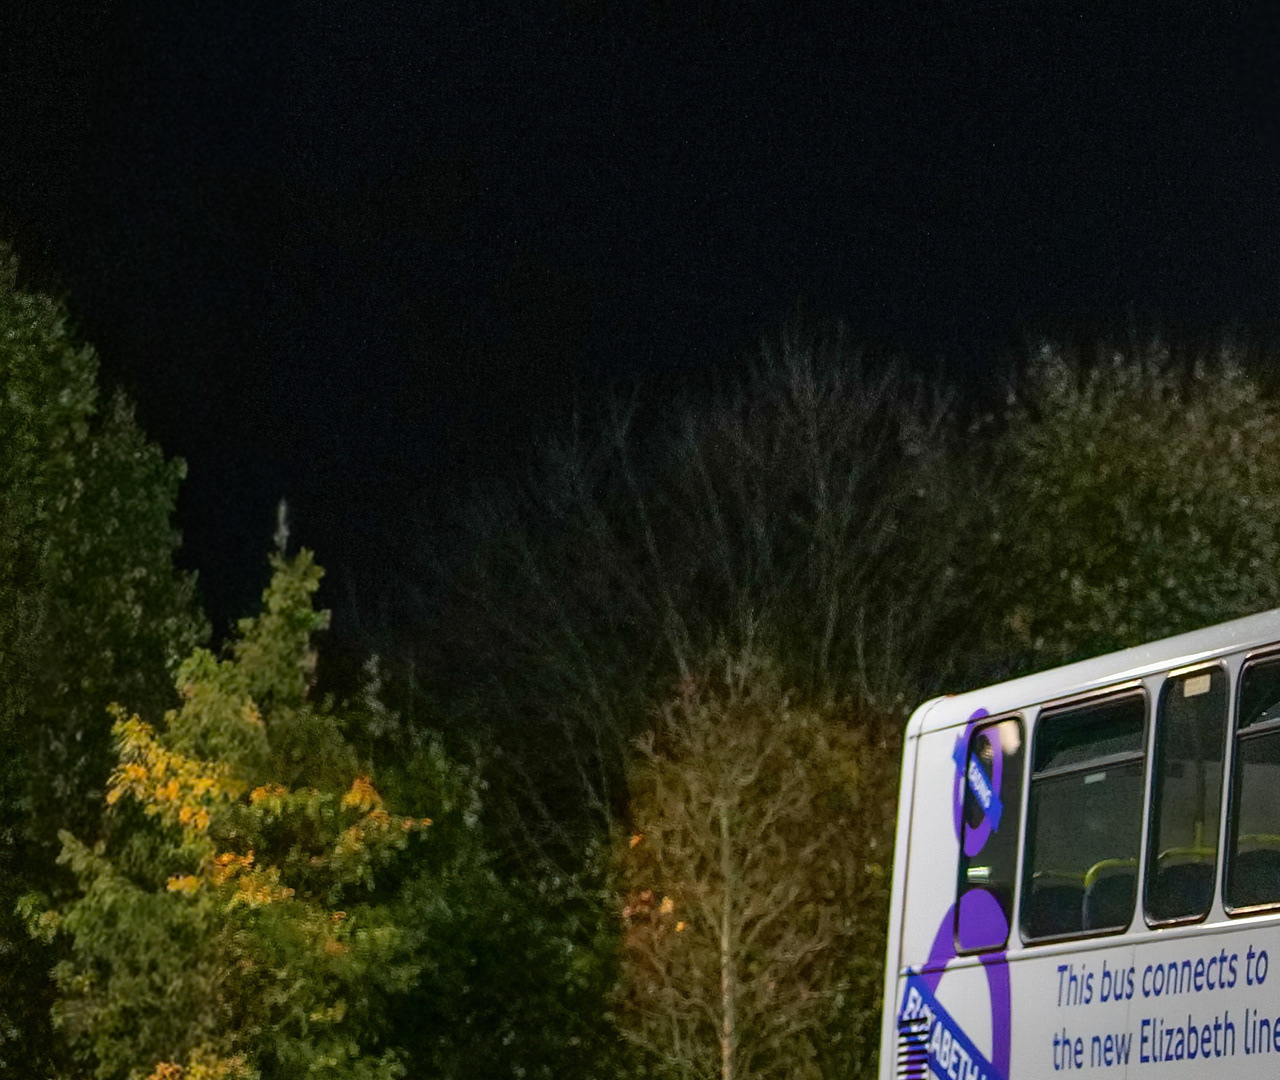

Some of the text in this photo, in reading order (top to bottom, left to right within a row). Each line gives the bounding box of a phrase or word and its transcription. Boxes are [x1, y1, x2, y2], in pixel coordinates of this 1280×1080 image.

[1057, 944, 1269, 1007] This bus connects to
[1053, 1027, 1084, 1071] the
[1090, 1032, 1133, 1068] new
[1140, 1010, 1236, 1064] Elizabeth
